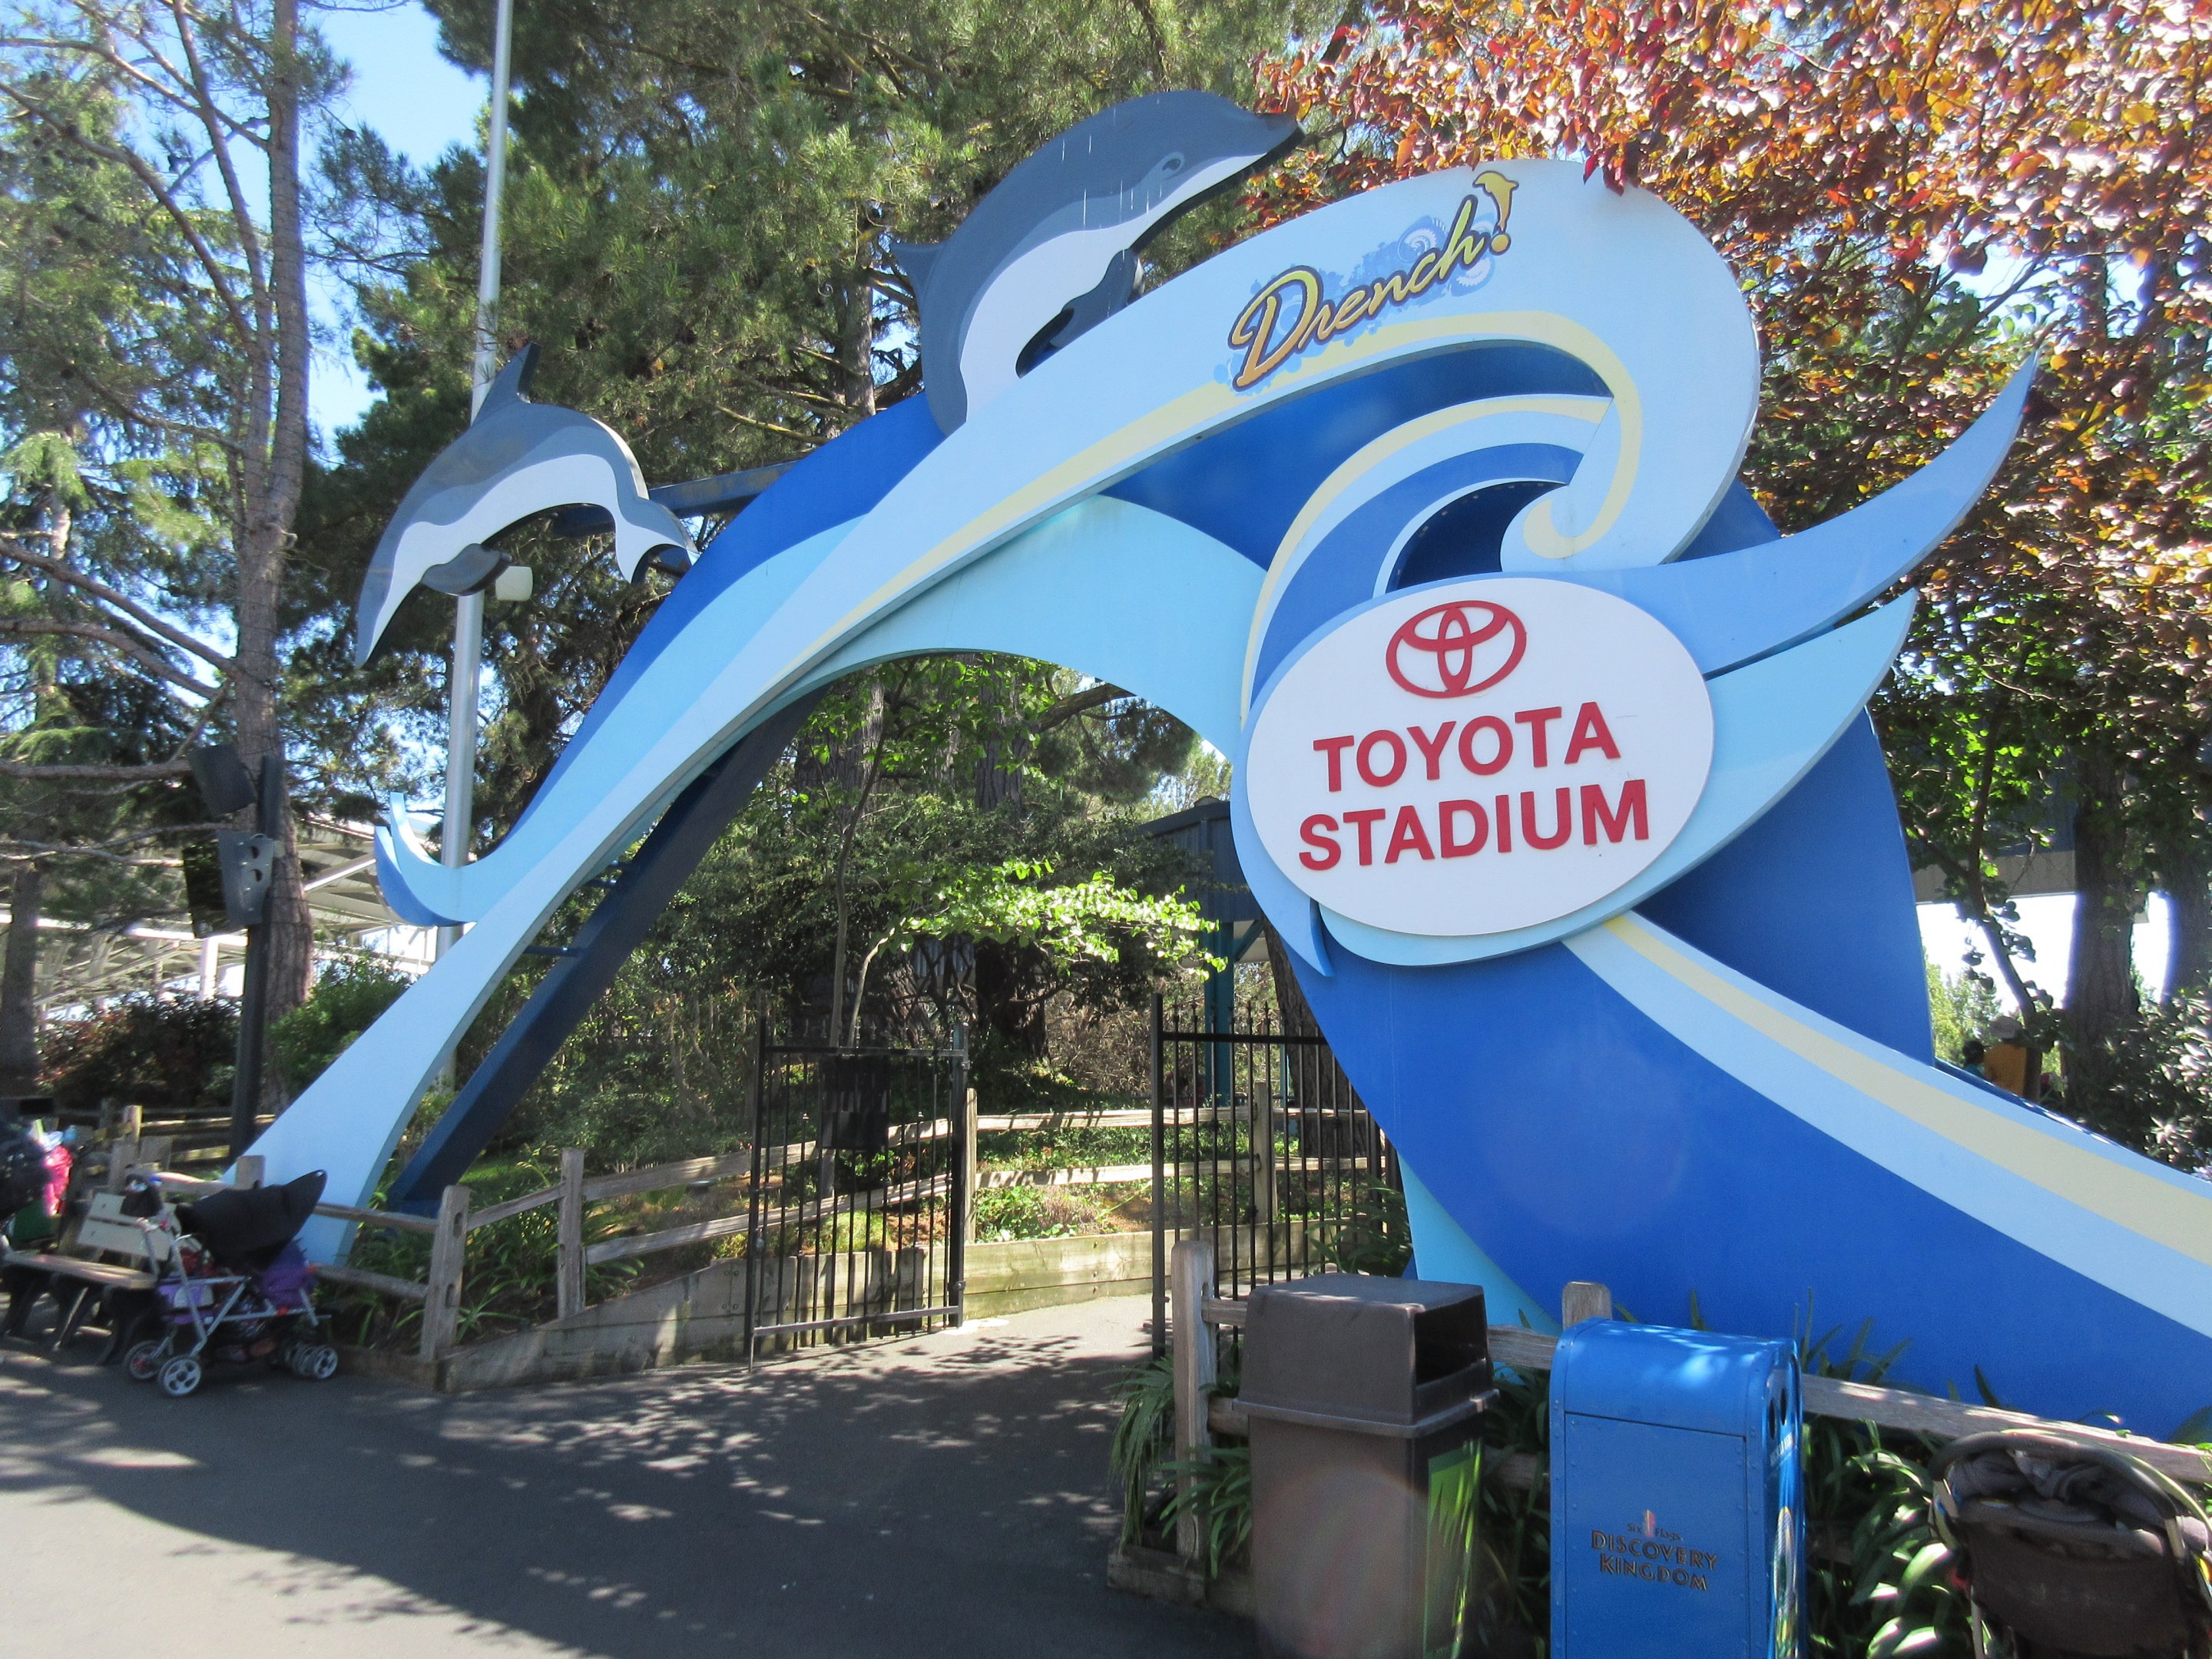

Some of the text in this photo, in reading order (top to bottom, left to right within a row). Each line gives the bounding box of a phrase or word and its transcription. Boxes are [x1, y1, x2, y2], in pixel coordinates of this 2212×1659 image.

[1313, 701, 1621, 793] TOYOTA
[1298, 779, 1650, 871] STADIUM
[1591, 1529, 1718, 1571] DISCOVERY
[1600, 1553, 1708, 1591] KINGDOM
